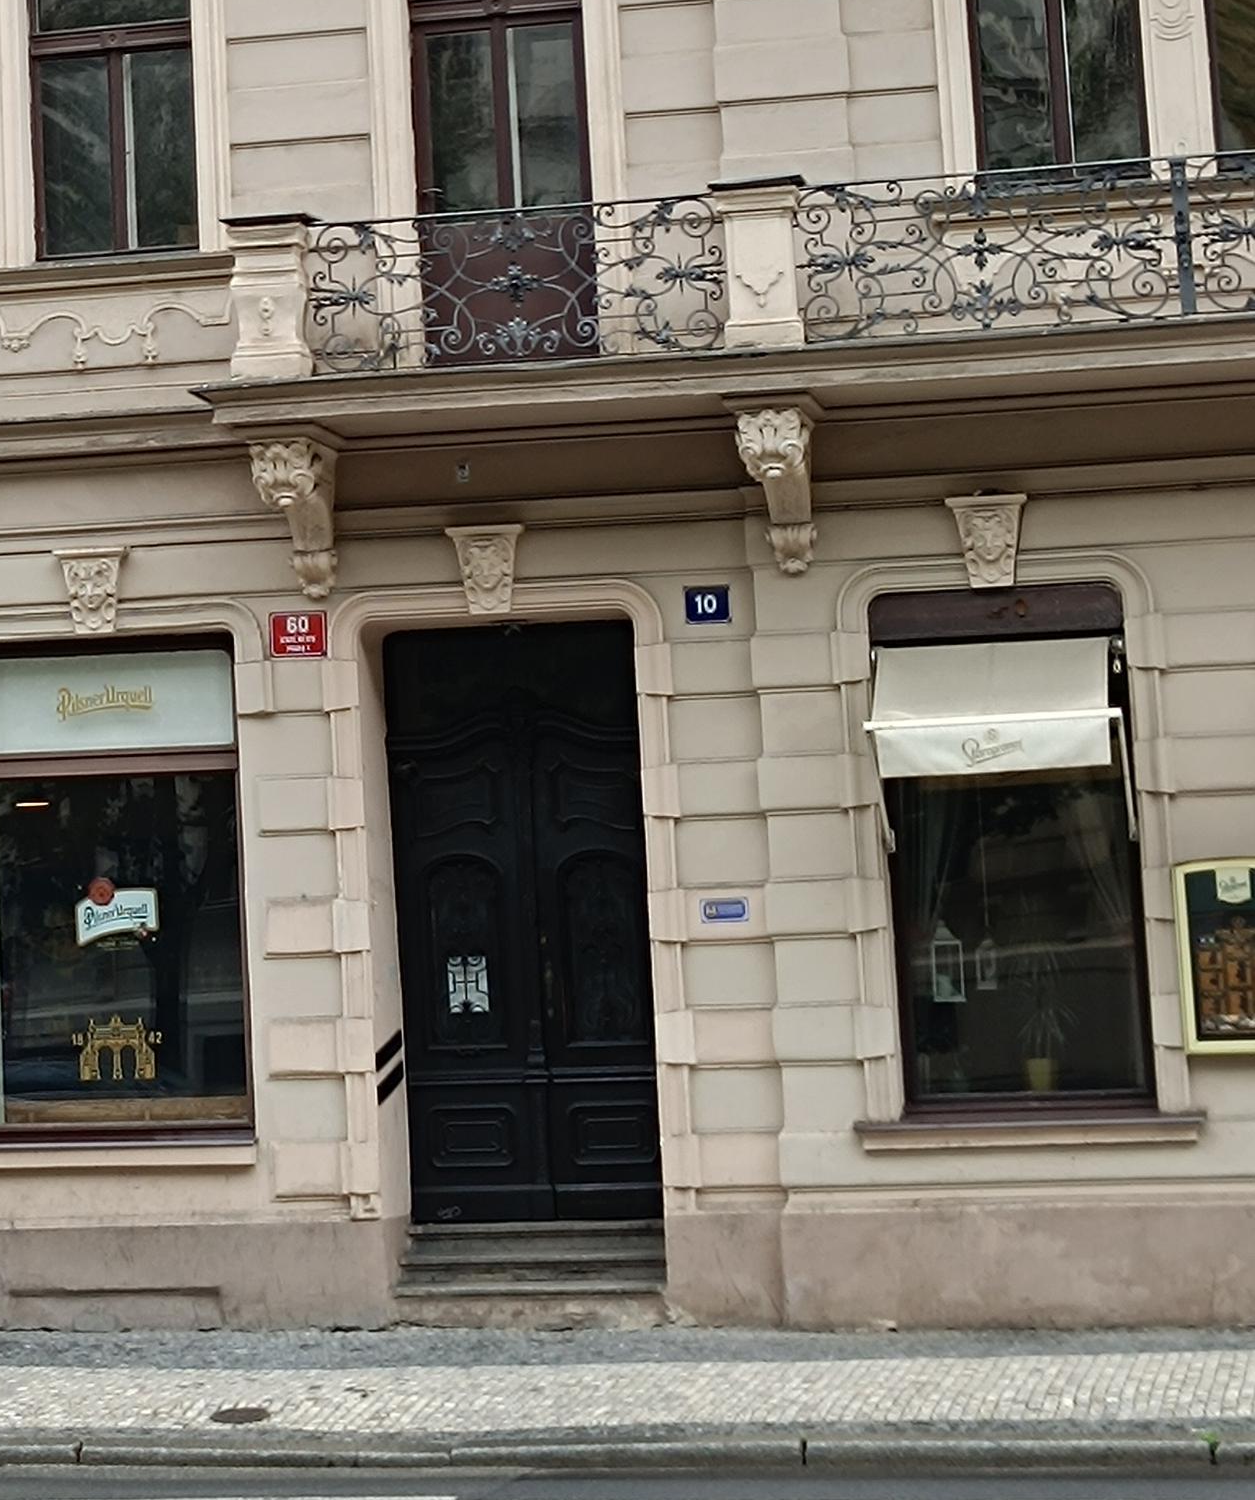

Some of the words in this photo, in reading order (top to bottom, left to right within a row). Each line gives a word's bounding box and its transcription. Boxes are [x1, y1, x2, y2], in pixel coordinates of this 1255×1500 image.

[695, 594, 717, 614] 10
[286, 615, 310, 634] 60
[57, 687, 105, 722] Pilsner
[148, 1031, 163, 1045] 42
